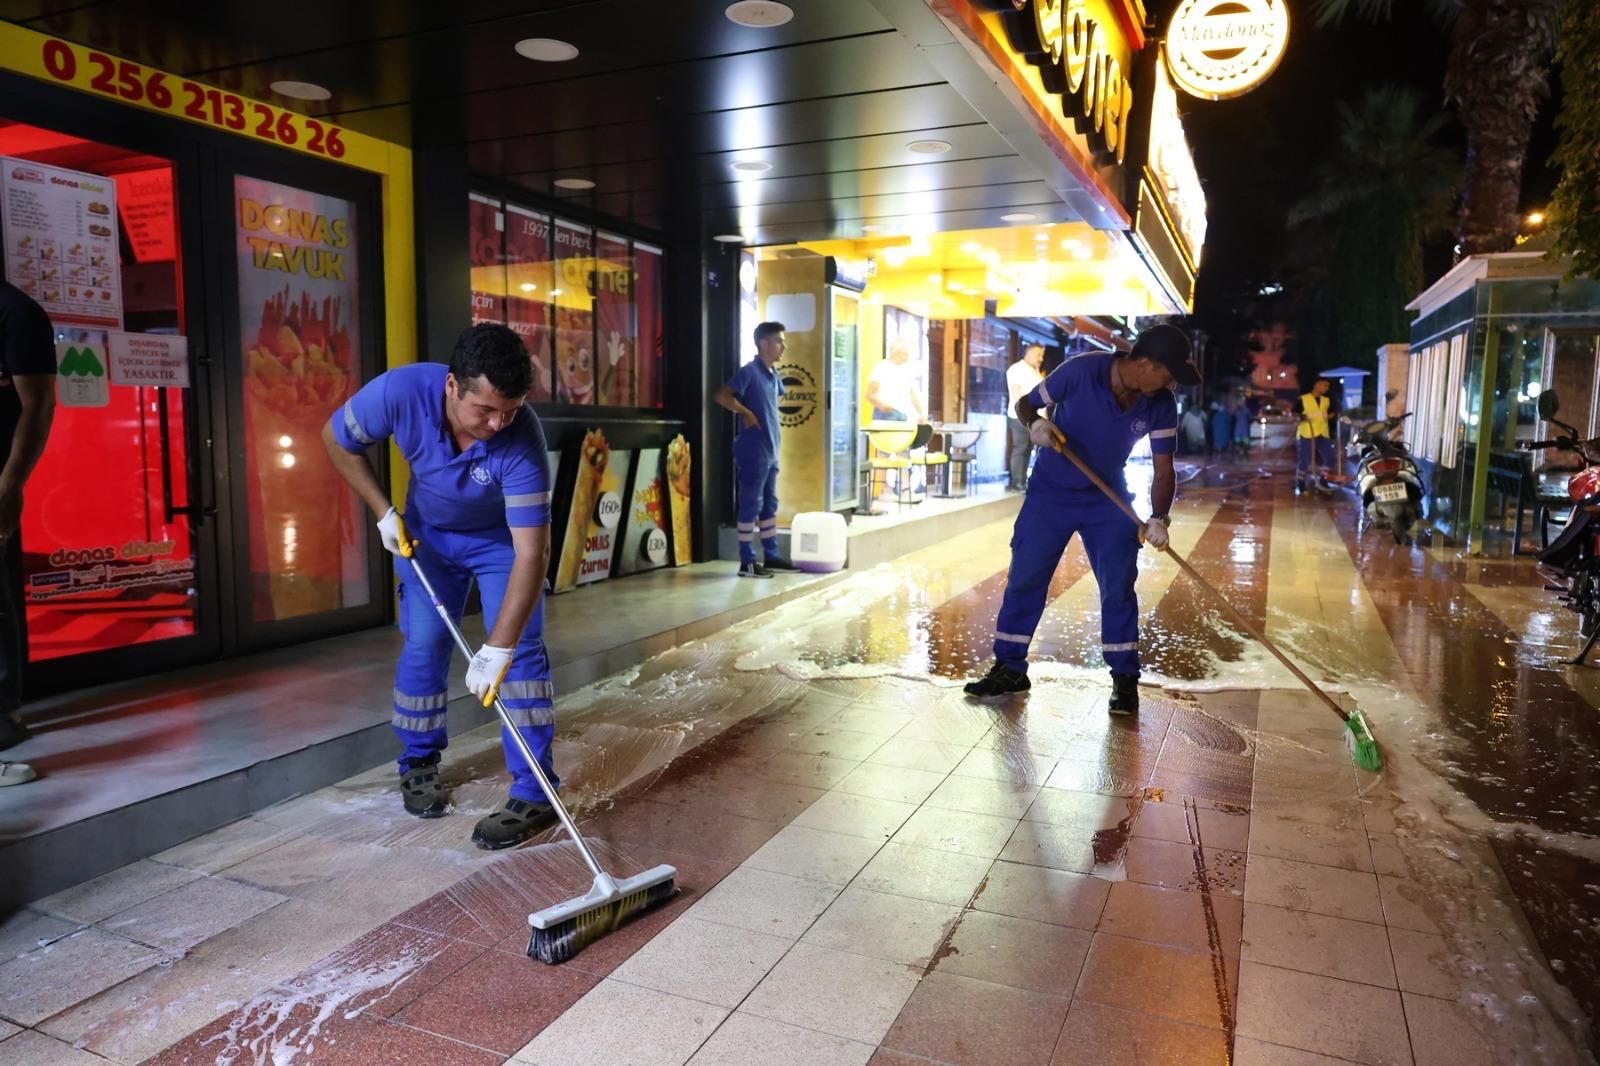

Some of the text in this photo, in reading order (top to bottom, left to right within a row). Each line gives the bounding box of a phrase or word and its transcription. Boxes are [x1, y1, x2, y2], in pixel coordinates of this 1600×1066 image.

[42, 39, 346, 159] 0 256 213 26 26
[240, 198, 349, 248] DONAS
[246, 236, 346, 282] TAVUK
[51, 547, 116, 566] donas
[579, 558, 609, 575] Zurna
